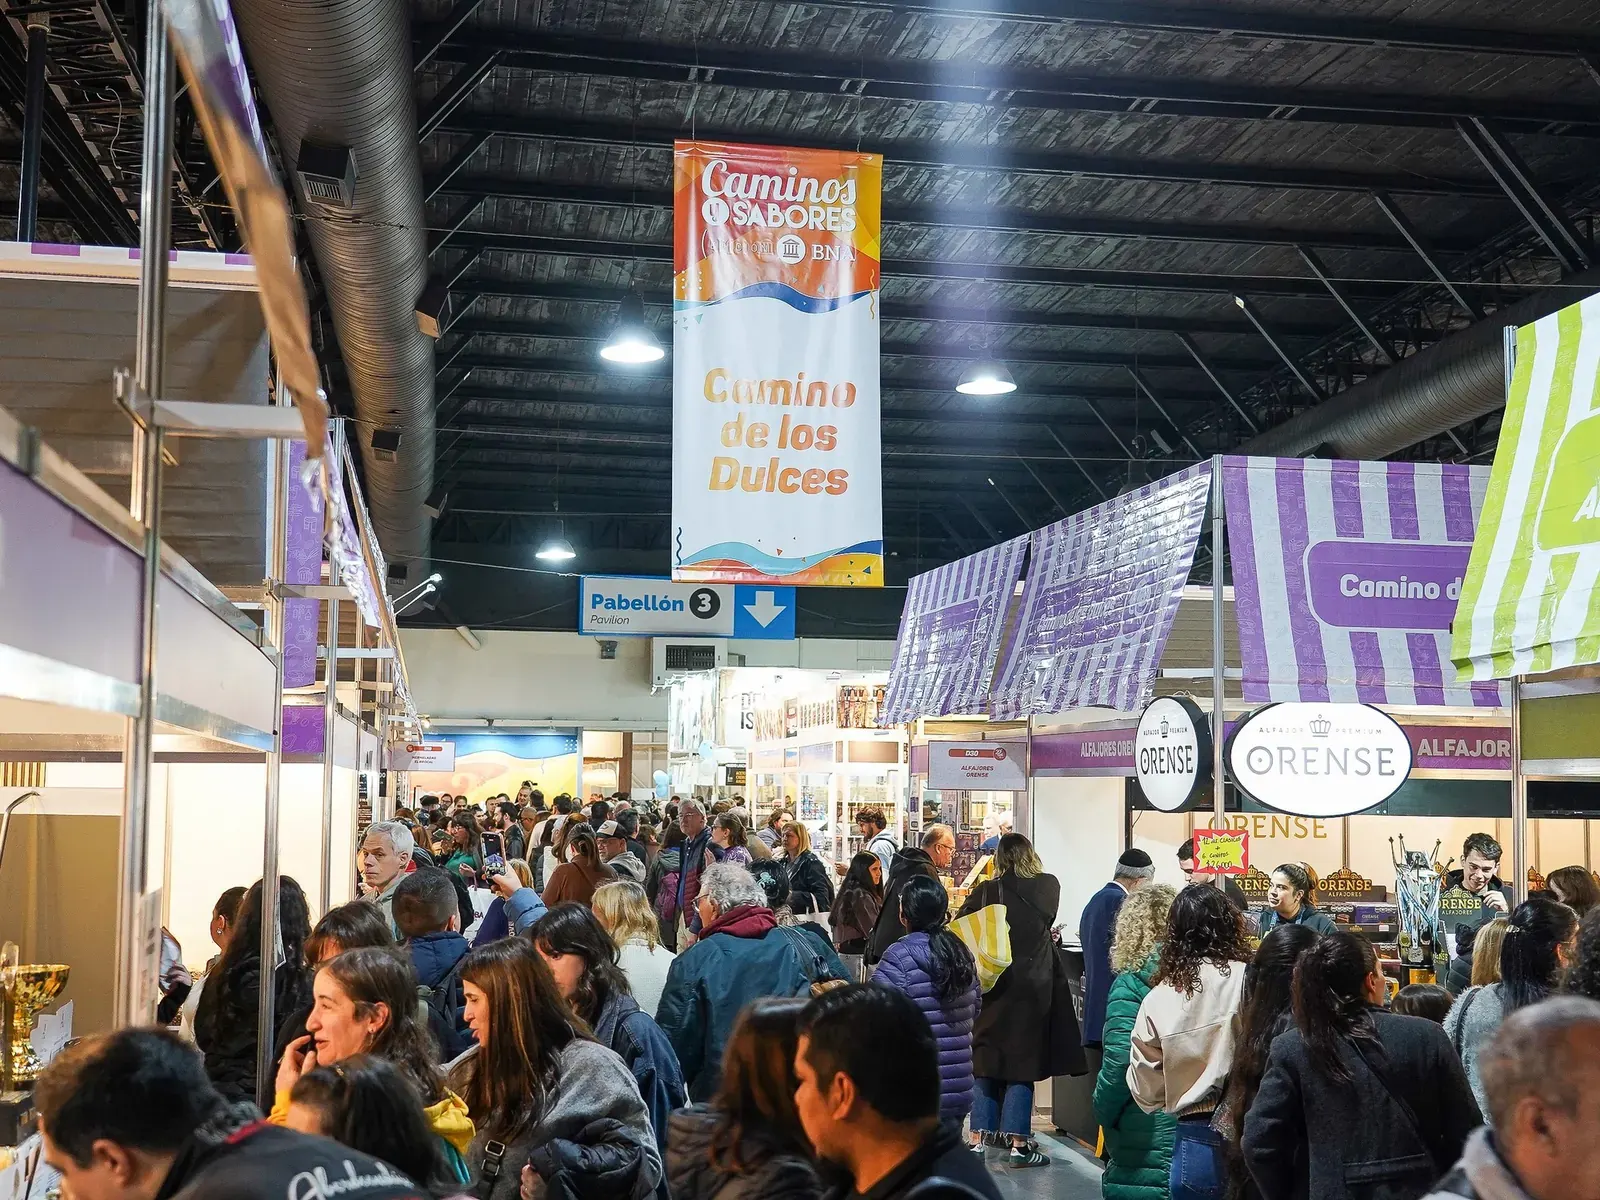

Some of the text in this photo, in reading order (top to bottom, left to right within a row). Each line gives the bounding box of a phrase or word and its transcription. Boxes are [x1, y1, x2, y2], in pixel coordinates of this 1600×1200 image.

[702, 159, 857, 205] Caminos
[732, 200, 857, 232] SABORES
[703, 367, 857, 408] Camino
[720, 411, 838, 452] de los
[708, 456, 849, 495] Dulces
[1340, 574, 1440, 600] Camino
[591, 593, 712, 613] Pabellón 3
[590, 614, 630, 625] Pavilion
[1259, 727, 1304, 735] ALFAJOR
[1080, 741, 1117, 757] ALFAJORES
[1140, 745, 1194, 775] ORENSE
[1246, 745, 1395, 776] ORENSE
[1417, 738, 1511, 757] ALFAJOR
[1318, 879, 1372, 891] ORENSE
